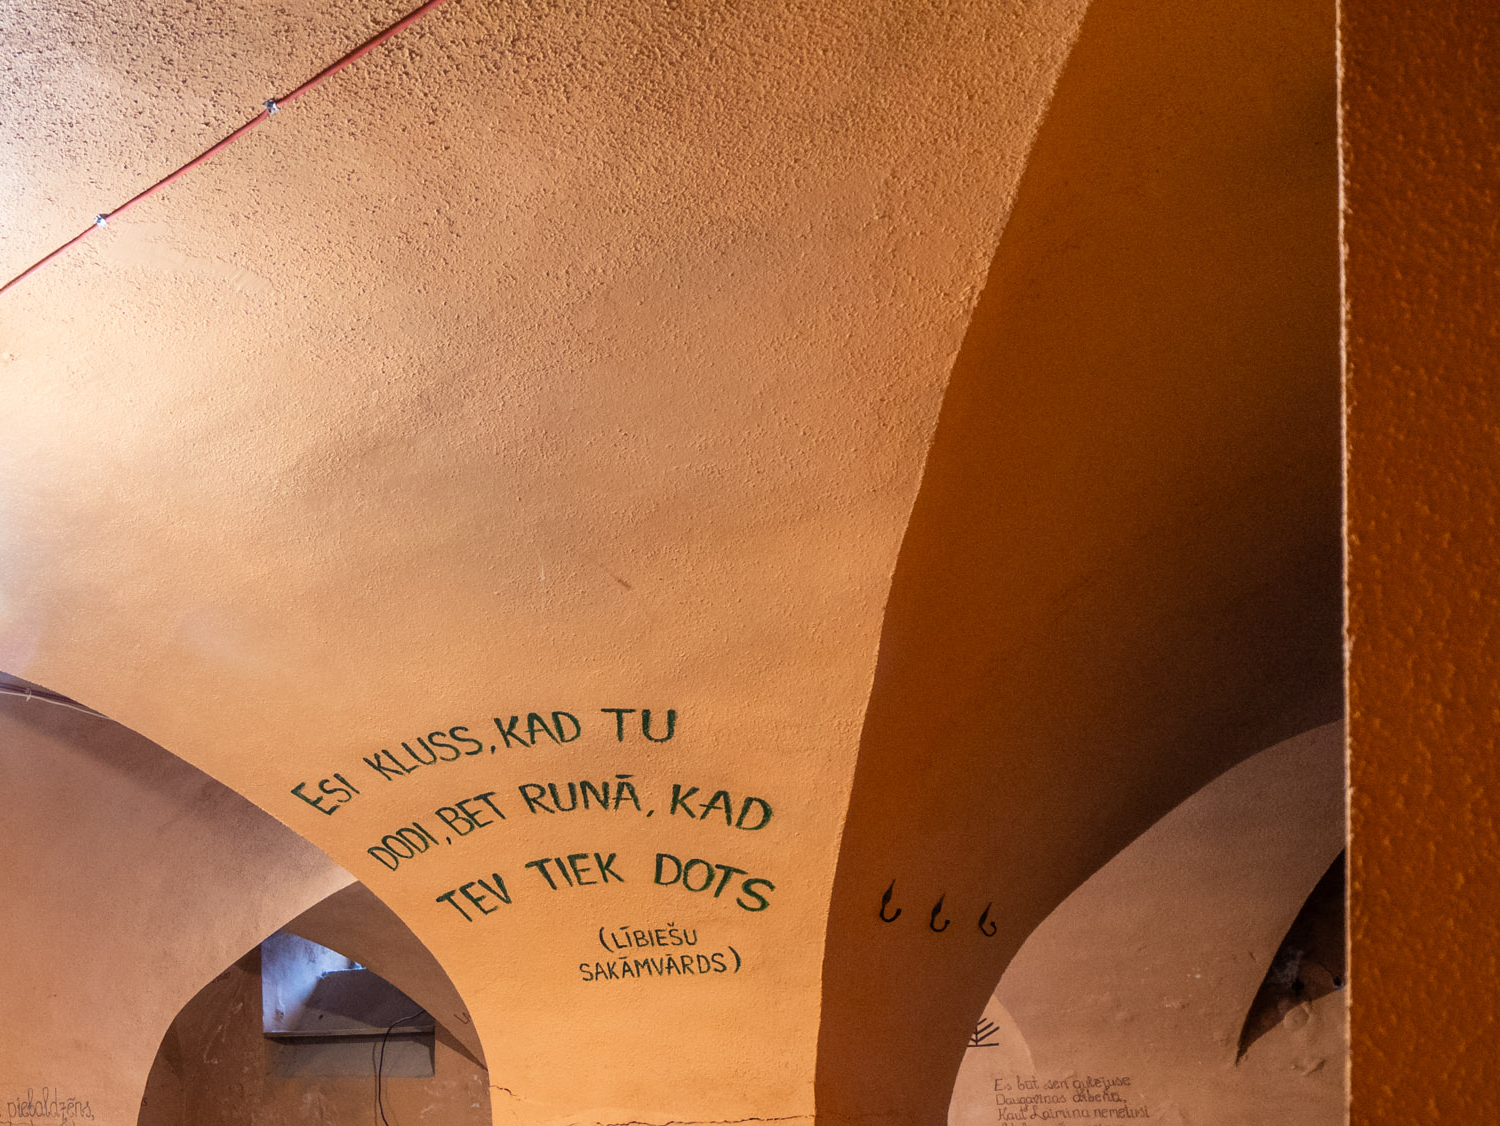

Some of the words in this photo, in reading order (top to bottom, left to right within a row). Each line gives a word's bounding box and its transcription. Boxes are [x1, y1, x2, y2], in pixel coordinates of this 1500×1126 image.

[494, 710, 582, 749] KAD
[600, 707, 678, 743] TU
[367, 821, 452, 872] DODI,
[435, 791, 507, 837] BET
[518, 774, 655, 818] RUNĀ,
[669, 784, 774, 831] KAD
[435, 873, 512, 923] TEV
[525, 852, 625, 891] TIEK
[653, 852, 775, 912] DOTS
[599, 922, 699, 953] (LĪBIEŠU
[579, 946, 742, 983] SAKĀMVĀRDS)
[994, 1078, 1012, 1091] Es
